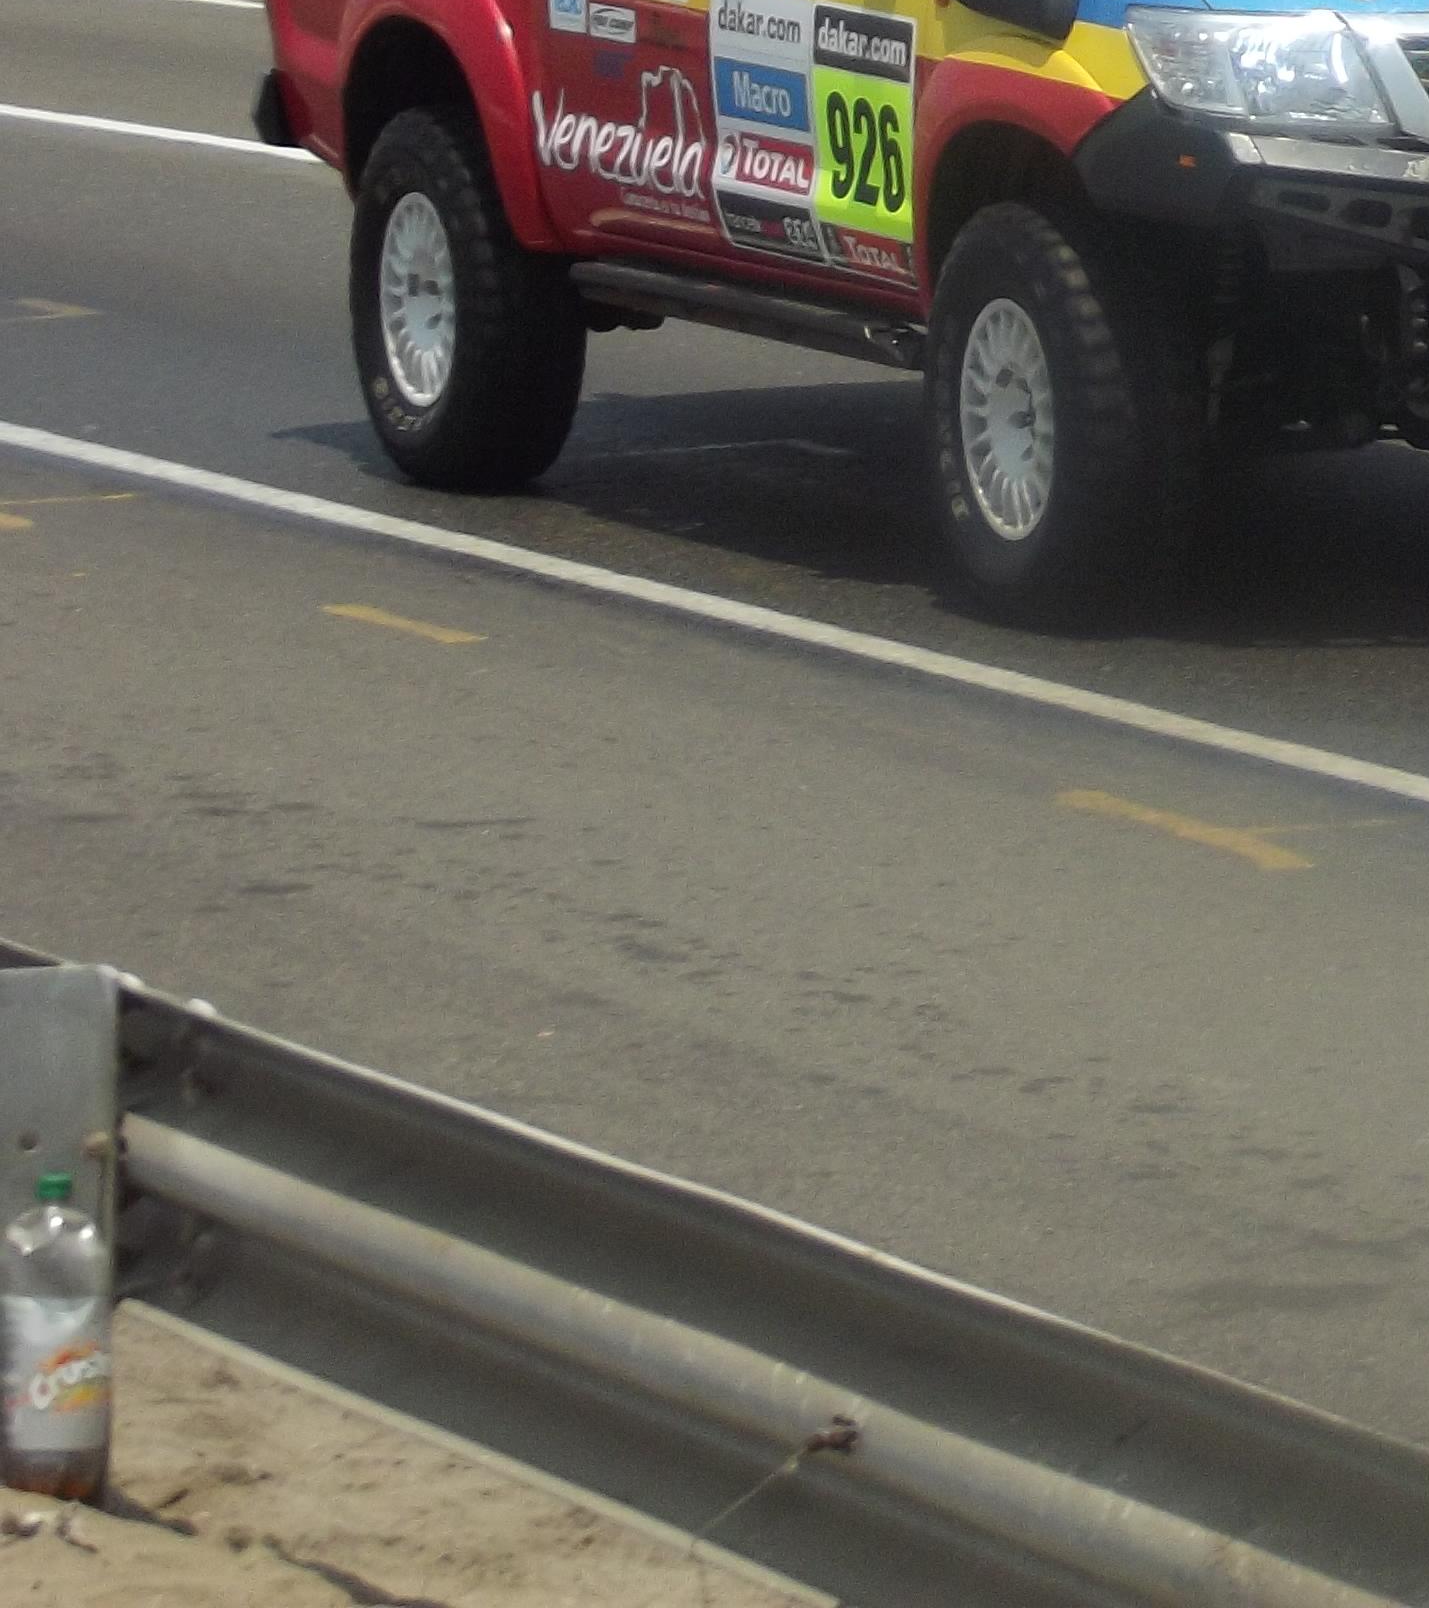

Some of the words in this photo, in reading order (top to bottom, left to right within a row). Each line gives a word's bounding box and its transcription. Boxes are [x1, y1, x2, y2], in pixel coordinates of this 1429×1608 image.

[718, 0, 801, 43] dakar.com
[817, 16, 906, 67] dakar.com
[732, 70, 792, 118] Macro
[531, 74, 707, 200] Venezuela
[826, 91, 906, 214] 926
[742, 138, 811, 189] TOTAL
